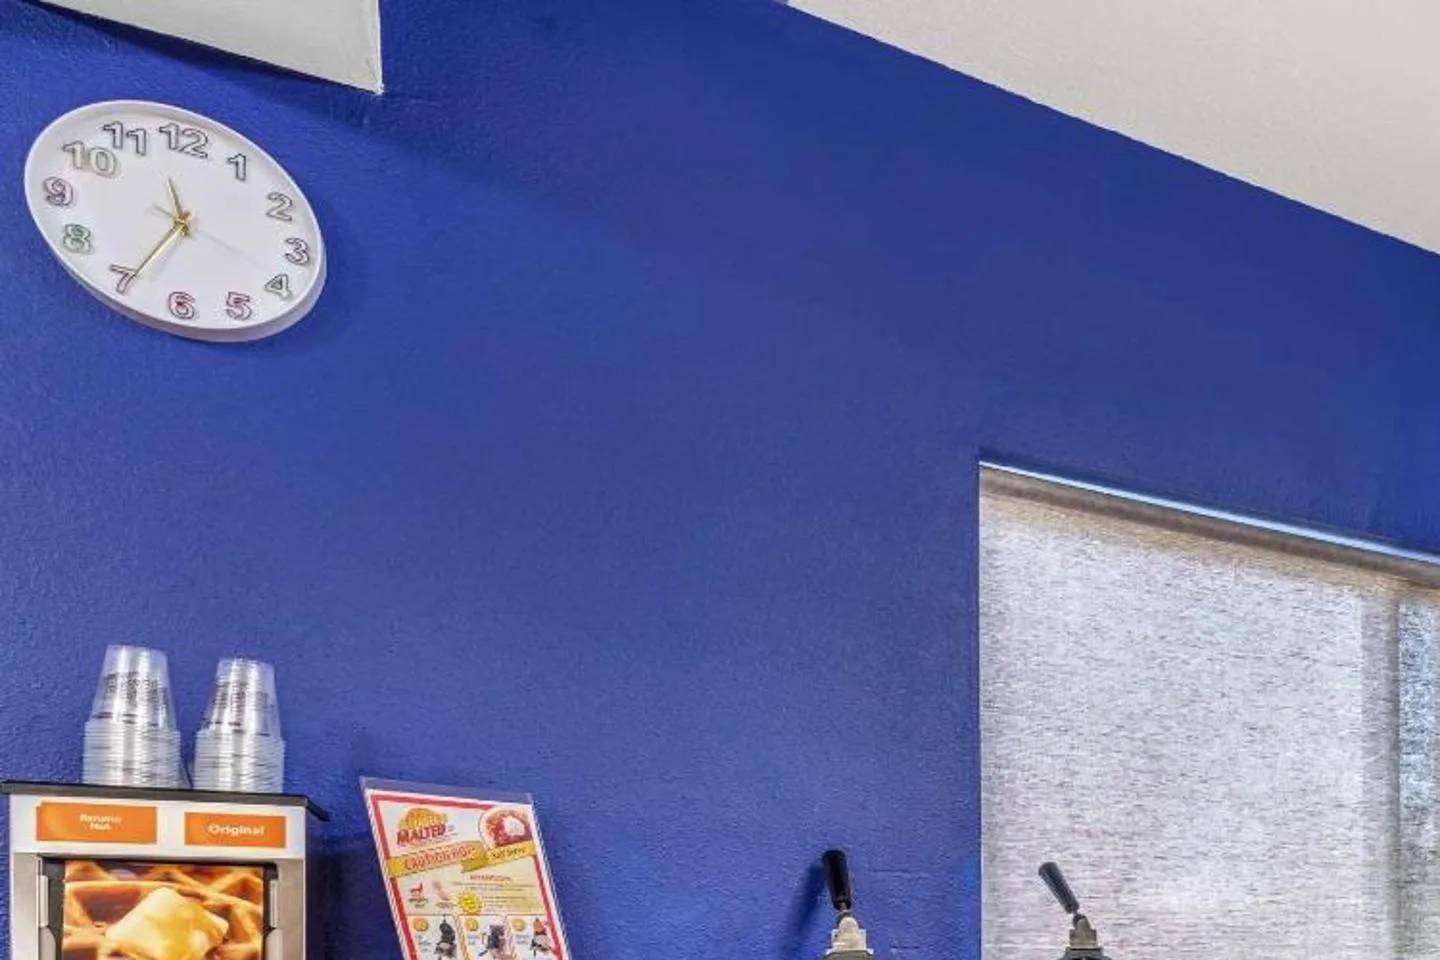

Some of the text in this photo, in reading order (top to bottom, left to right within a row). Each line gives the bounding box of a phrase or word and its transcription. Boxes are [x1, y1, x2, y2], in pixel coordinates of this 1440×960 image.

[103, 120, 148, 156] 11
[159, 122, 209, 159] 12
[63, 140, 117, 177] 10
[227, 153, 247, 181] 1
[43, 177, 74, 206] 9
[266, 191, 293, 222] 2
[62, 224, 92, 252] 8
[284, 238, 310, 265] 3
[110, 264, 137, 294] 7
[265, 273, 293, 300] 4
[168, 292, 196, 319] 6
[226, 292, 252, 320] 5
[207, 823, 265, 837] Original
